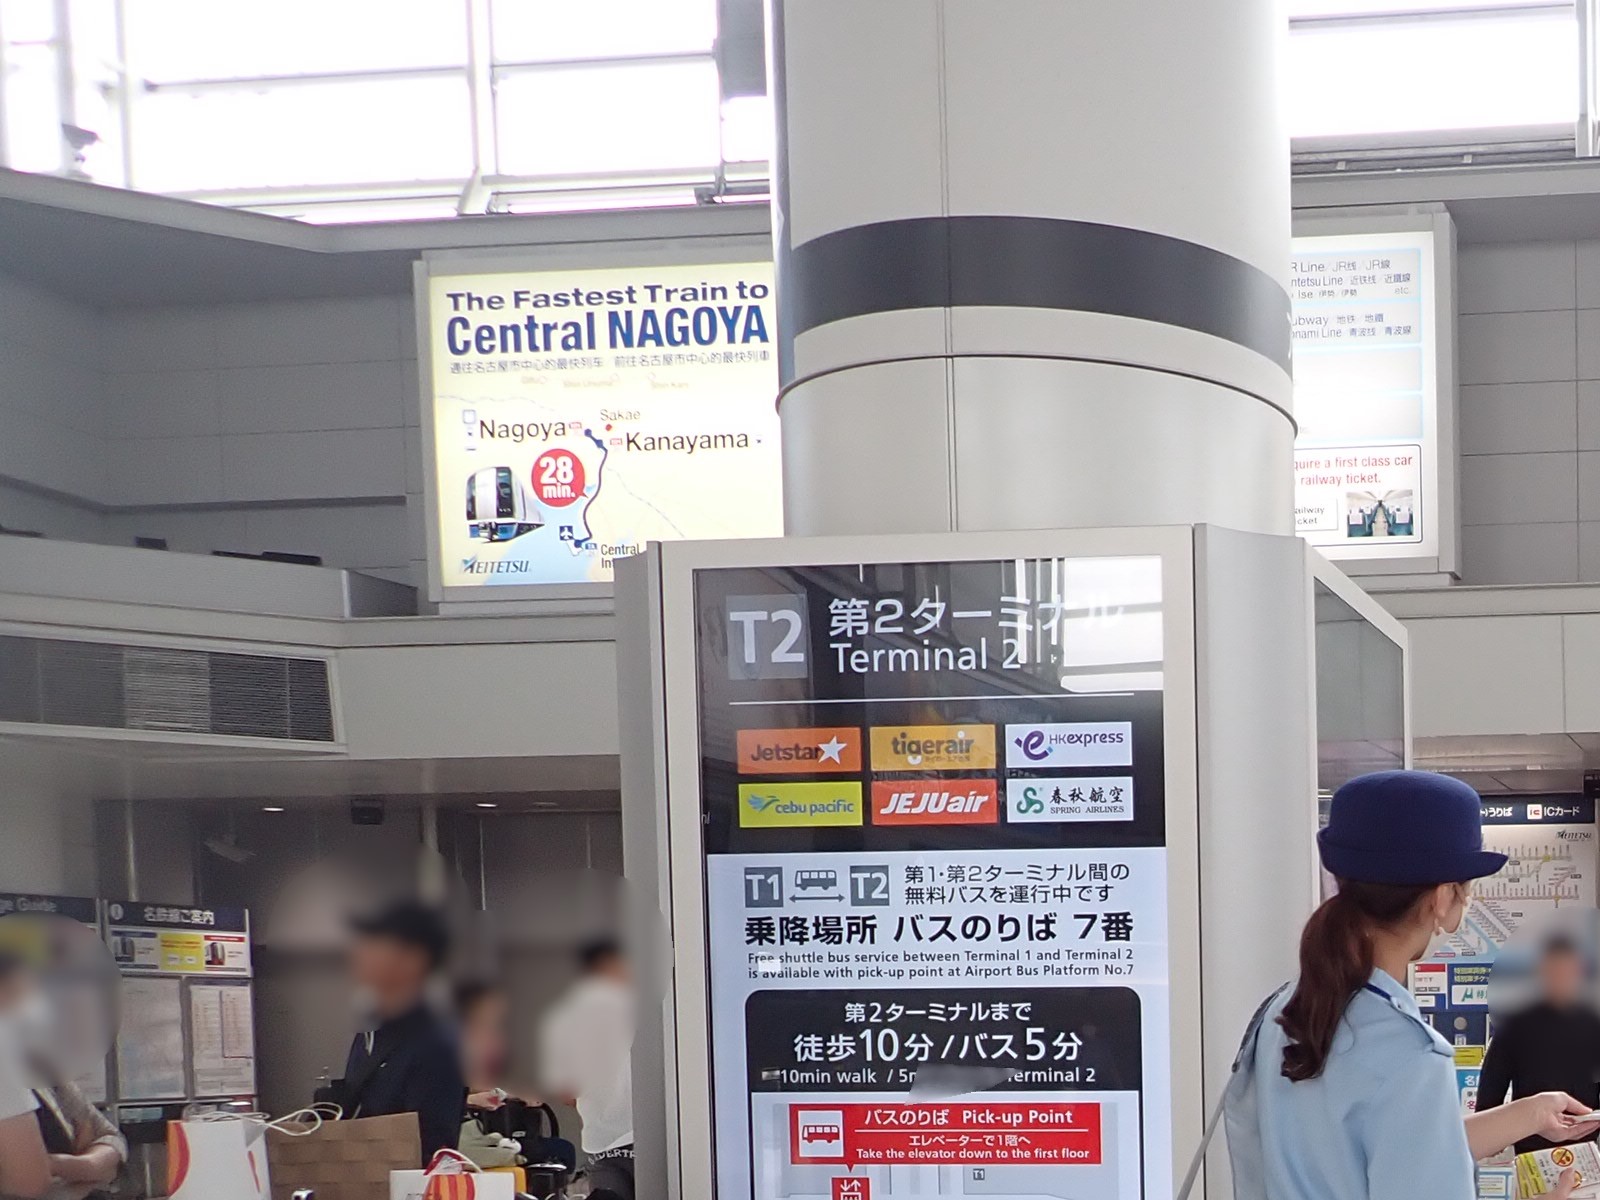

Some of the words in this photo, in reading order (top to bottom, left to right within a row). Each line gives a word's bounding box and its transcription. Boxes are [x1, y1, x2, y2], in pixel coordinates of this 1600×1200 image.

[1300, 261, 1325, 273] Line
[1323, 276, 1343, 287] Line
[447, 292, 505, 312] The
[513, 285, 636, 309] Fastest
[643, 281, 728, 303] Train
[737, 281, 769, 300] to
[1292, 315, 1329, 327] ubway
[447, 312, 596, 356] Central
[608, 305, 769, 349] NAGOYA
[1322, 328, 1342, 338] Line
[600, 409, 640, 422] Sakae
[480, 419, 566, 441] Nagoya
[626, 432, 749, 454] Kanayama
[539, 457, 573, 485] 28
[1294, 460, 1320, 471] quire
[1324, 459, 1331, 468] a
[1335, 457, 1358, 468] first
[1362, 456, 1390, 466] class
[1394, 457, 1413, 466] car
[1301, 474, 1342, 486] railway
[542, 484, 575, 498] min.
[1294, 505, 1325, 515] ailway
[600, 544, 640, 556] Central
[828, 594, 1125, 637] 第2ターミナ
[729, 609, 804, 664] T2
[829, 638, 987, 673] Terminal
[1003, 641, 1022, 670] 2
[892, 731, 974, 765] tigerair
[1049, 731, 1124, 748] HKexpress
[751, 743, 822, 763] Jetstar
[879, 789, 989, 815] JEJUair
[1050, 786, 1124, 804] 春秋航空
[775, 801, 807, 816] cebu
[809, 799, 855, 818] pacific
[1050, 806, 1081, 815] SPRING
[1085, 805, 1125, 814] AIRLINES
[1543, 806, 1580, 817] ICカード
[745, 873, 783, 900] T1
[851, 872, 889, 899] T2
[904, 884, 1114, 905] 無料バスを運行中です
[745, 914, 877, 947] 乗降場所
[893, 912, 1056, 943] バスのりば
[1072, 911, 1135, 943] 7番
[748, 953, 776, 964] Free
[778, 952, 824, 963] shuttle
[828, 951, 850, 963] bus
[854, 951, 899, 963] service
[903, 950, 961, 962] between
[965, 949, 1021, 962] Terminal
[1035, 949, 1061, 961] and
[1065, 948, 1122, 960] Terminal
[1126, 948, 1134, 960] 2
[748, 967, 759, 978] is
[762, 966, 819, 978] available
[823, 966, 854, 978] with
[857, 966, 904, 980] pick-up
[908, 966, 943, 979] point
[947, 966, 961, 977] at
[965, 965, 1012, 979] Airport
[1016, 965, 1039, 977] Bus
[1043, 964, 1100, 976] Platform
[1104, 964, 1134, 976] No.7
[844, 1002, 1032, 1023] 第2ターミナルまで
[780, 1069, 832, 1083] 10min
[837, 1069, 876, 1083] walk
[1086, 1069, 1095, 1082] 2
[864, 1109, 949, 1126] バスのりば
[963, 1110, 1022, 1127] Pick-up
[1029, 1110, 1073, 1124] Point
[909, 1135, 1030, 1147] エレベーターで1階へ
[856, 1149, 880, 1159] Take
[885, 1149, 904, 1159] the
[908, 1148, 956, 1159] elevator
[959, 1149, 992, 1159] down
[996, 1149, 1007, 1159] to
[1011, 1148, 1030, 1159] the
[1034, 1148, 1058, 1159] first
[1061, 1148, 1090, 1159] floor
